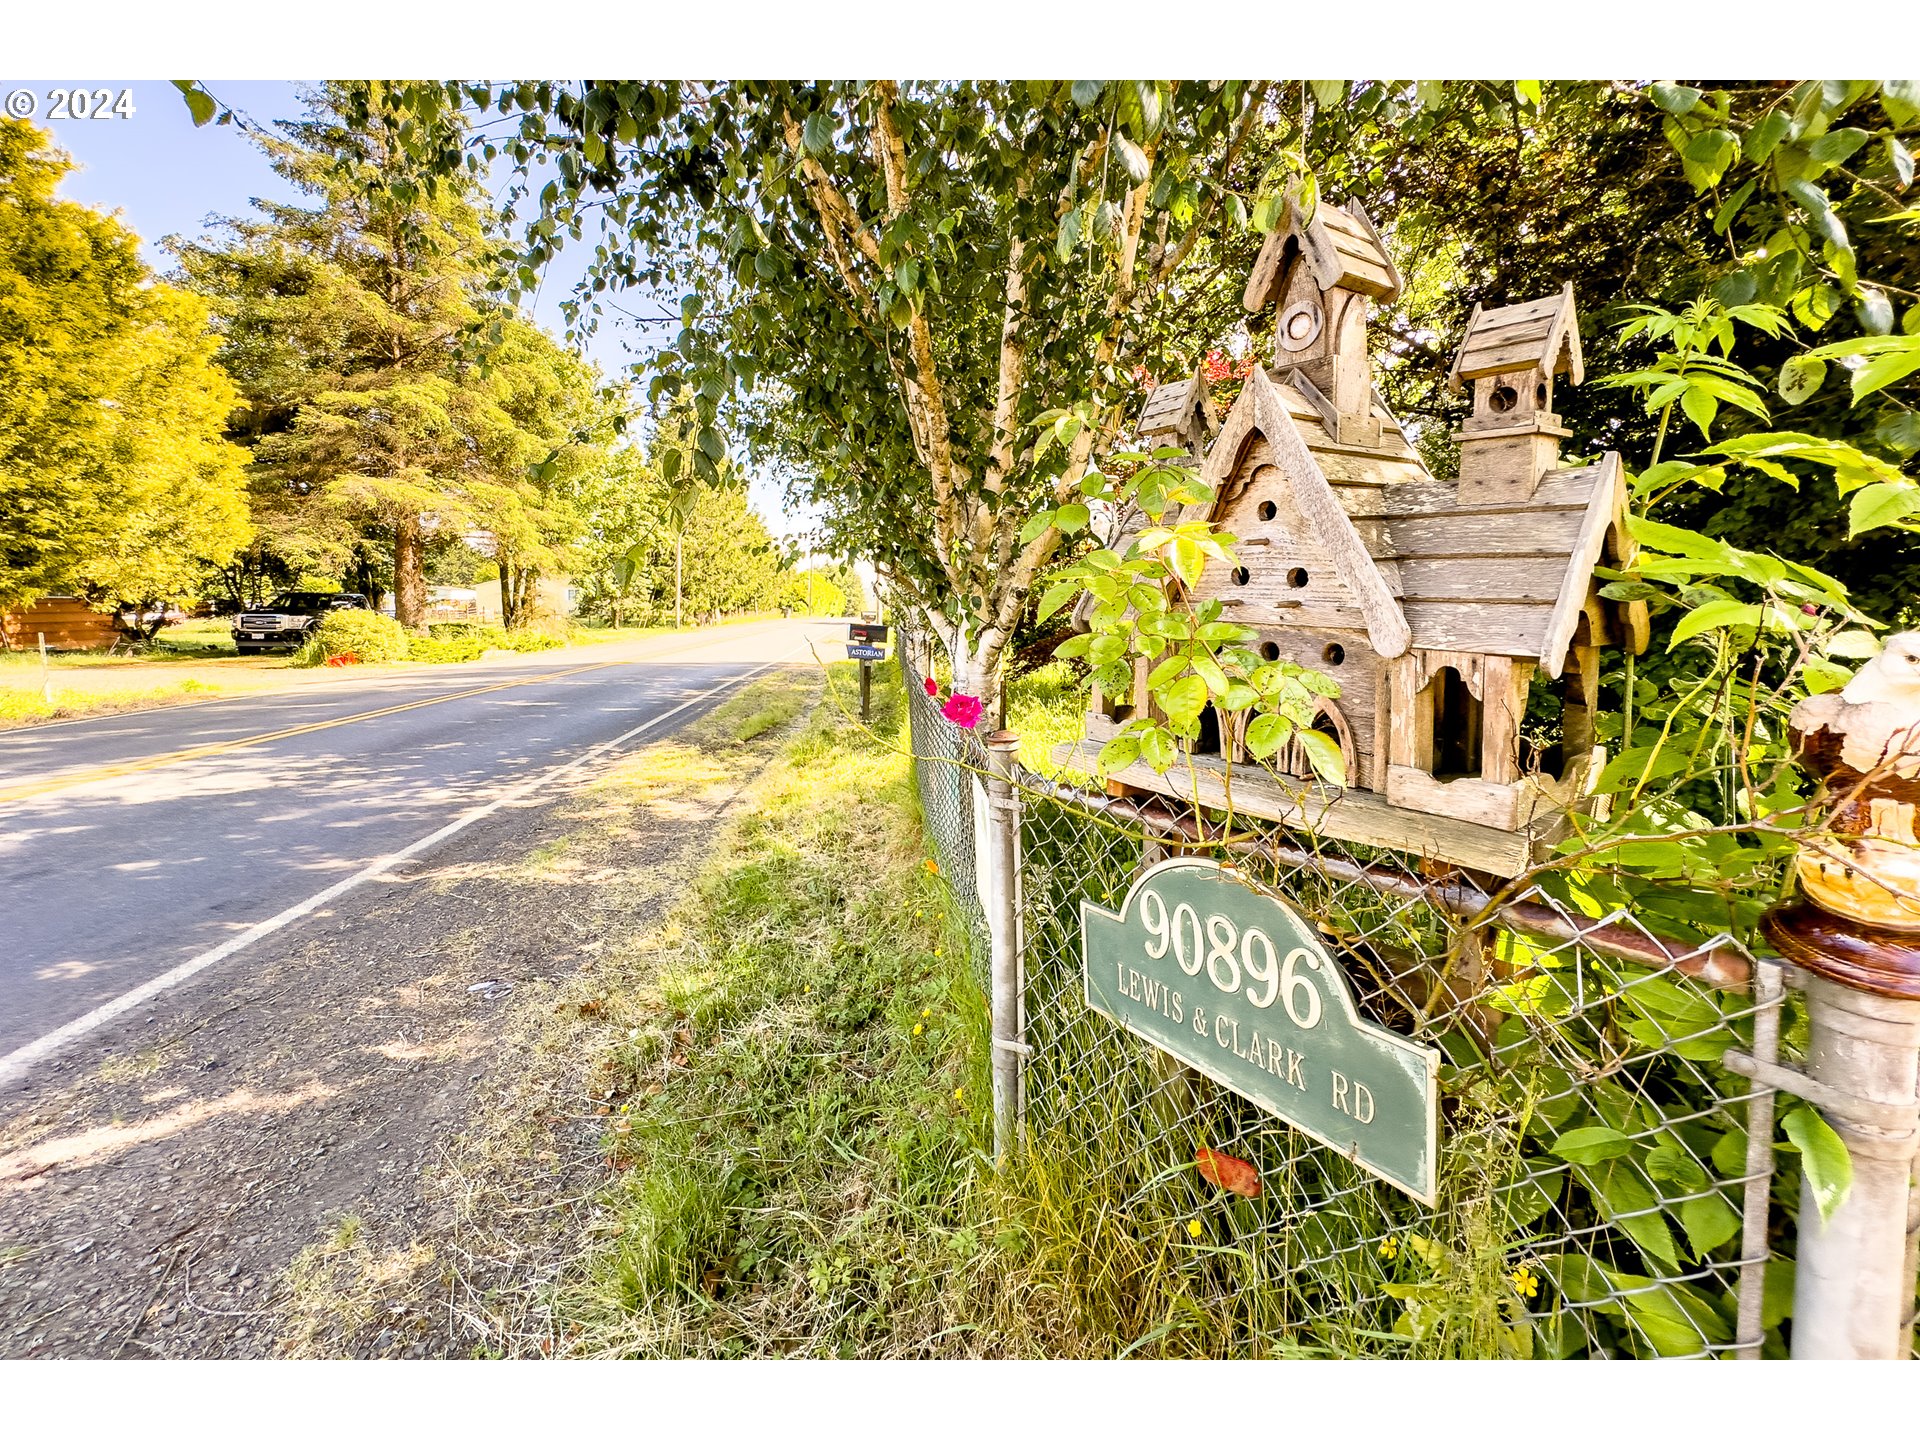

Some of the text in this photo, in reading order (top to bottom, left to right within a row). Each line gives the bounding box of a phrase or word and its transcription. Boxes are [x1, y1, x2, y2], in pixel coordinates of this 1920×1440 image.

[851, 648, 884, 657] ASTORIAN
[1139, 889, 1322, 1029] 90896
[1117, 962, 1376, 1125] LEWIS & CLARK RD
